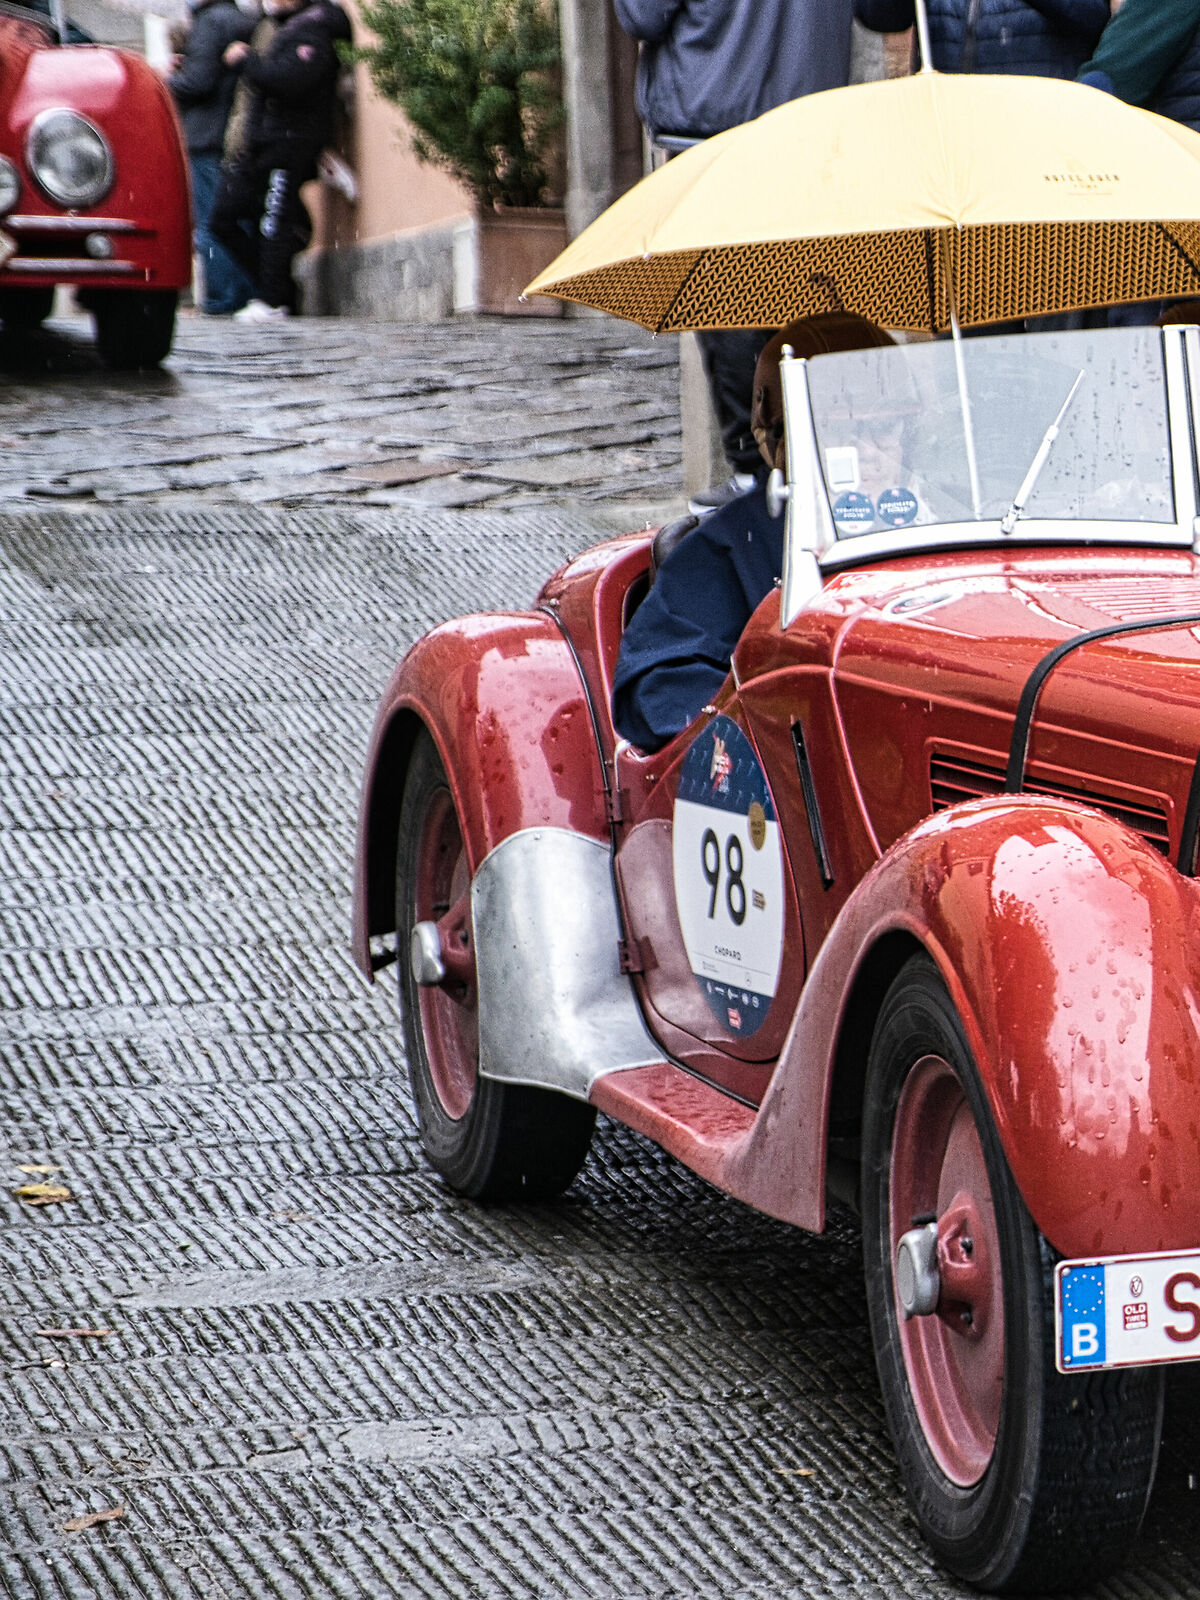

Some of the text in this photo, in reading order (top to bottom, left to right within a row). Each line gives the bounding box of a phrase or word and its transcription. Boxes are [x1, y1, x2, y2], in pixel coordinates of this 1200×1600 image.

[700, 827, 747, 926] 98
[1124, 1304, 1147, 1315] OLD
[1125, 1314, 1146, 1323] TIMER
[1072, 1322, 1099, 1357] B
